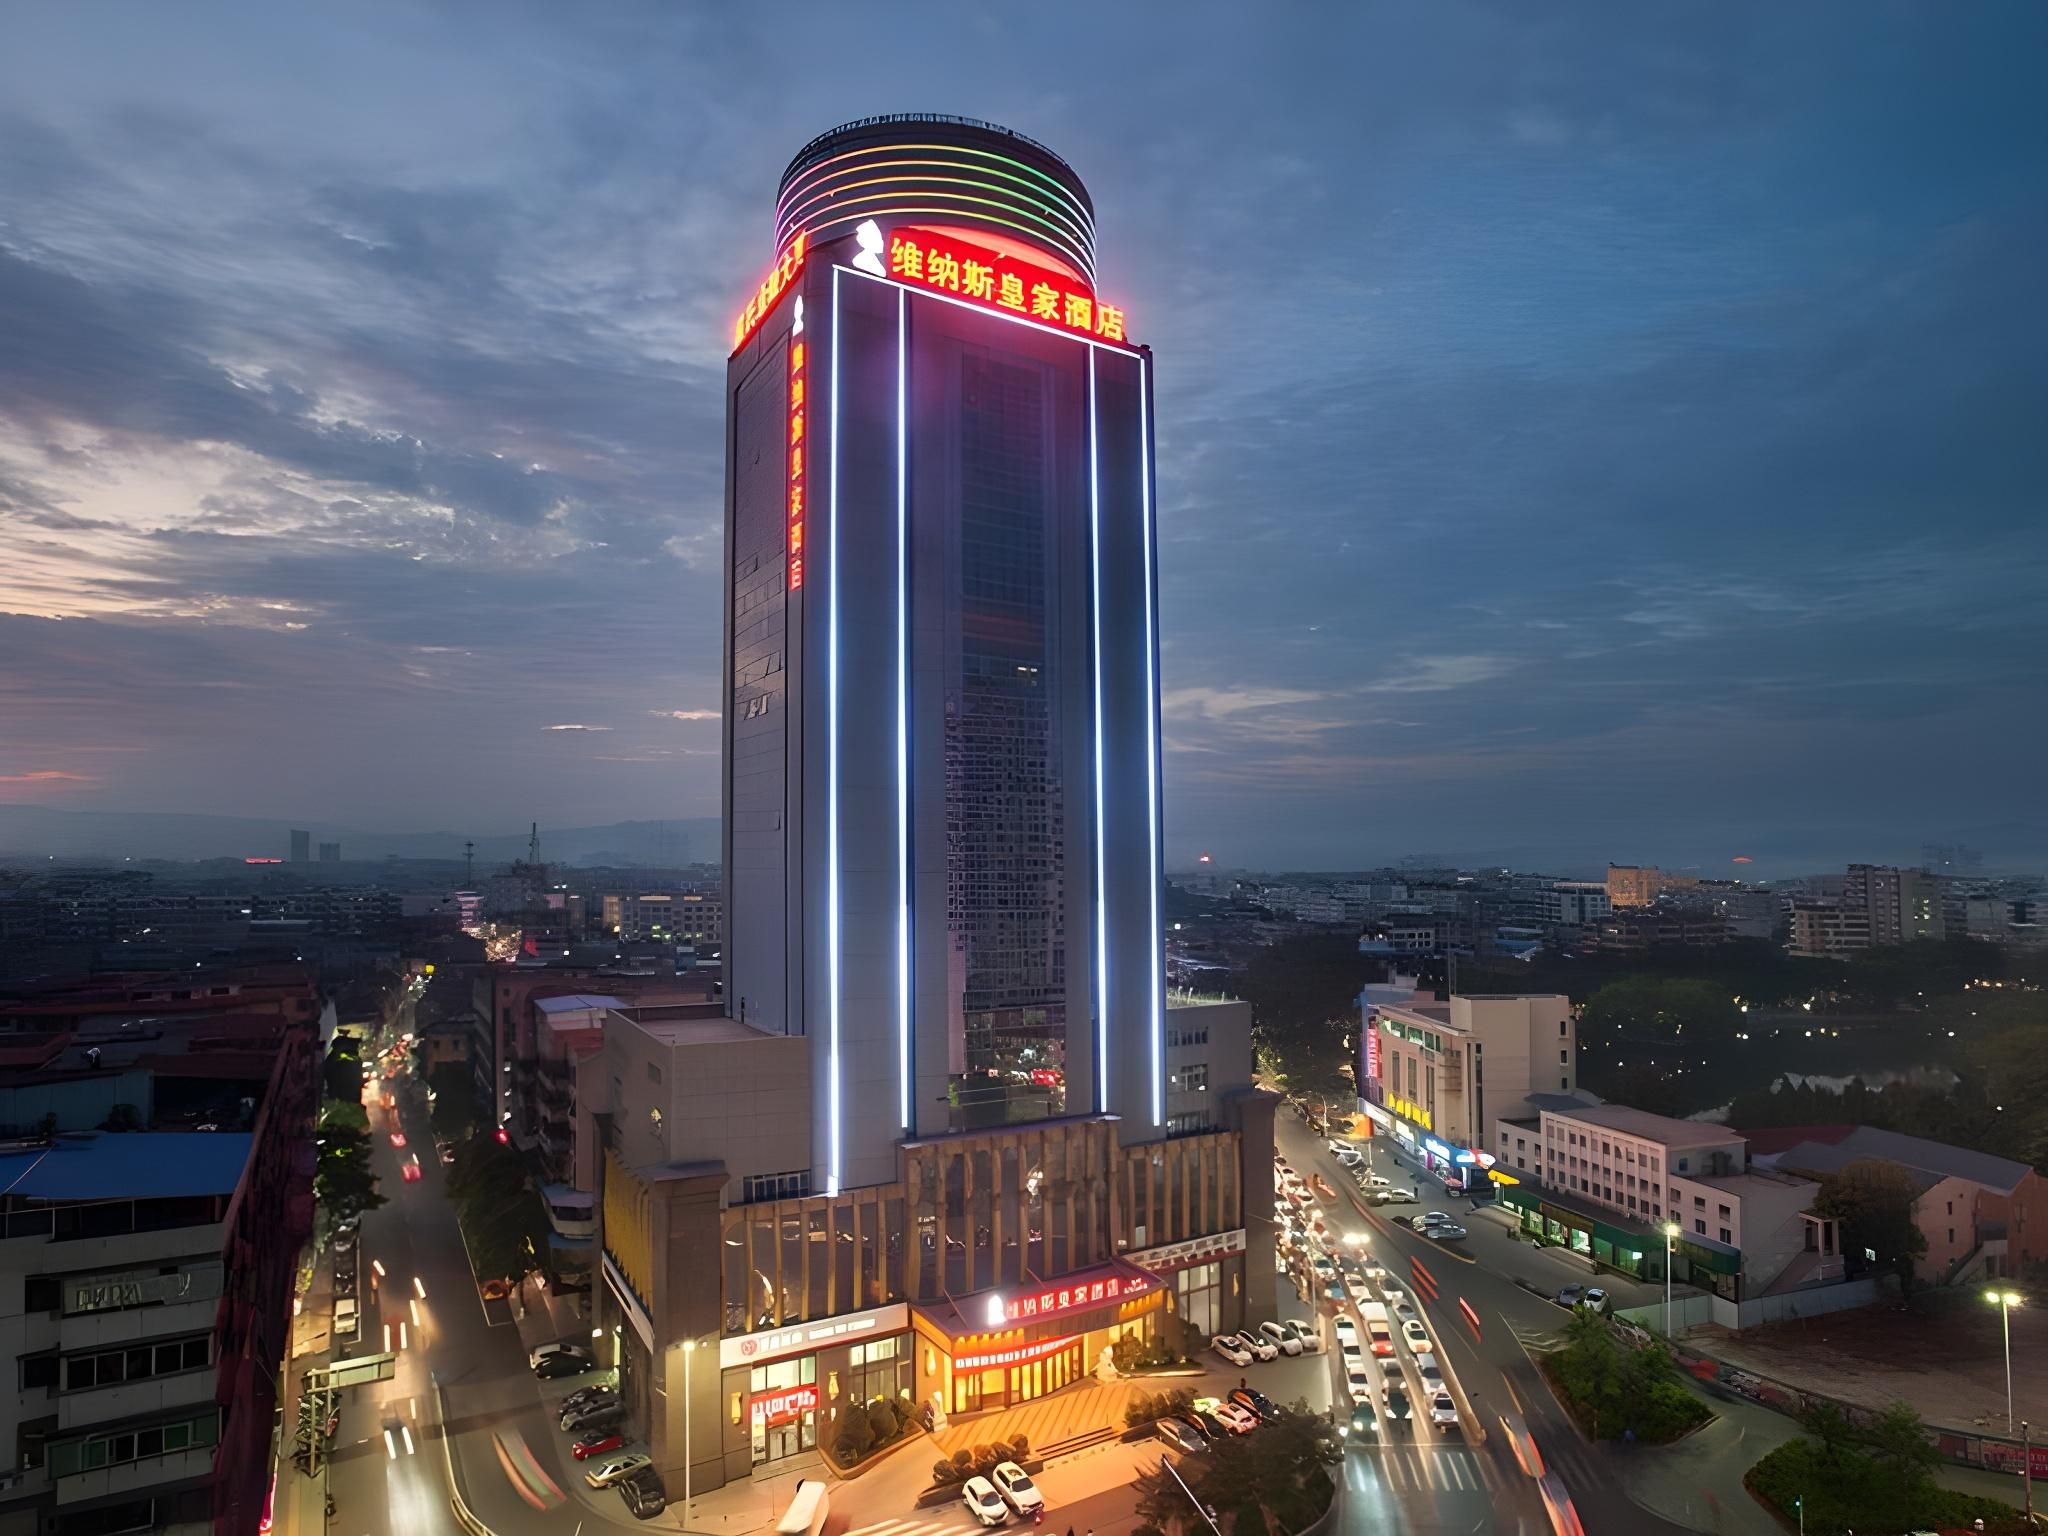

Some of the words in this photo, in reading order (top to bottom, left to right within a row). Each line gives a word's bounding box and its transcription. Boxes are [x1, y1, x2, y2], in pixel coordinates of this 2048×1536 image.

[891, 238, 1124, 341] 维纳斯皇家酒店
